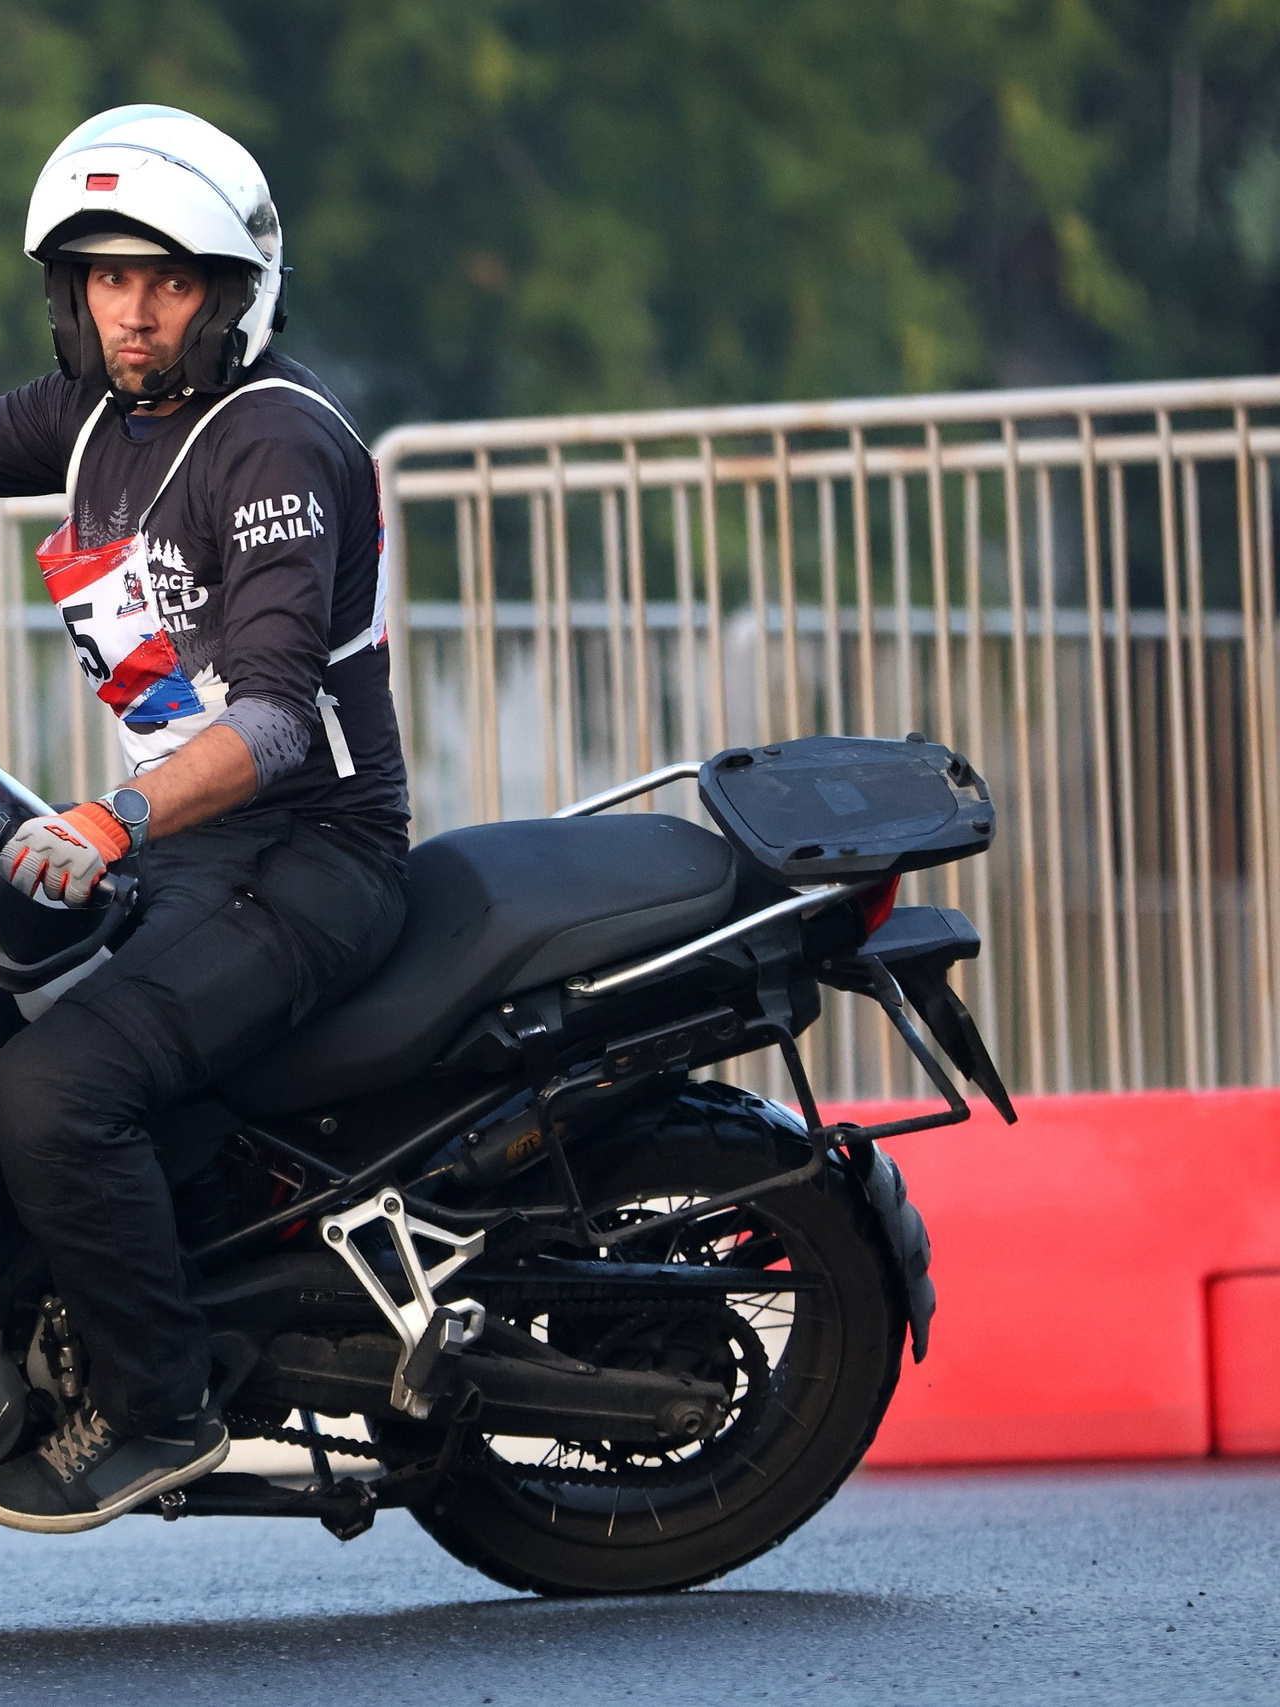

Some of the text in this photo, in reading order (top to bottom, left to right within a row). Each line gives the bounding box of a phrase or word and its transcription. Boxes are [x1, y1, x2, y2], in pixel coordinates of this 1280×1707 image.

[233, 494, 301, 529] WILD
[232, 517, 312, 552] TRAIL
[158, 586, 209, 615] LD
[161, 613, 197, 634] AIL
